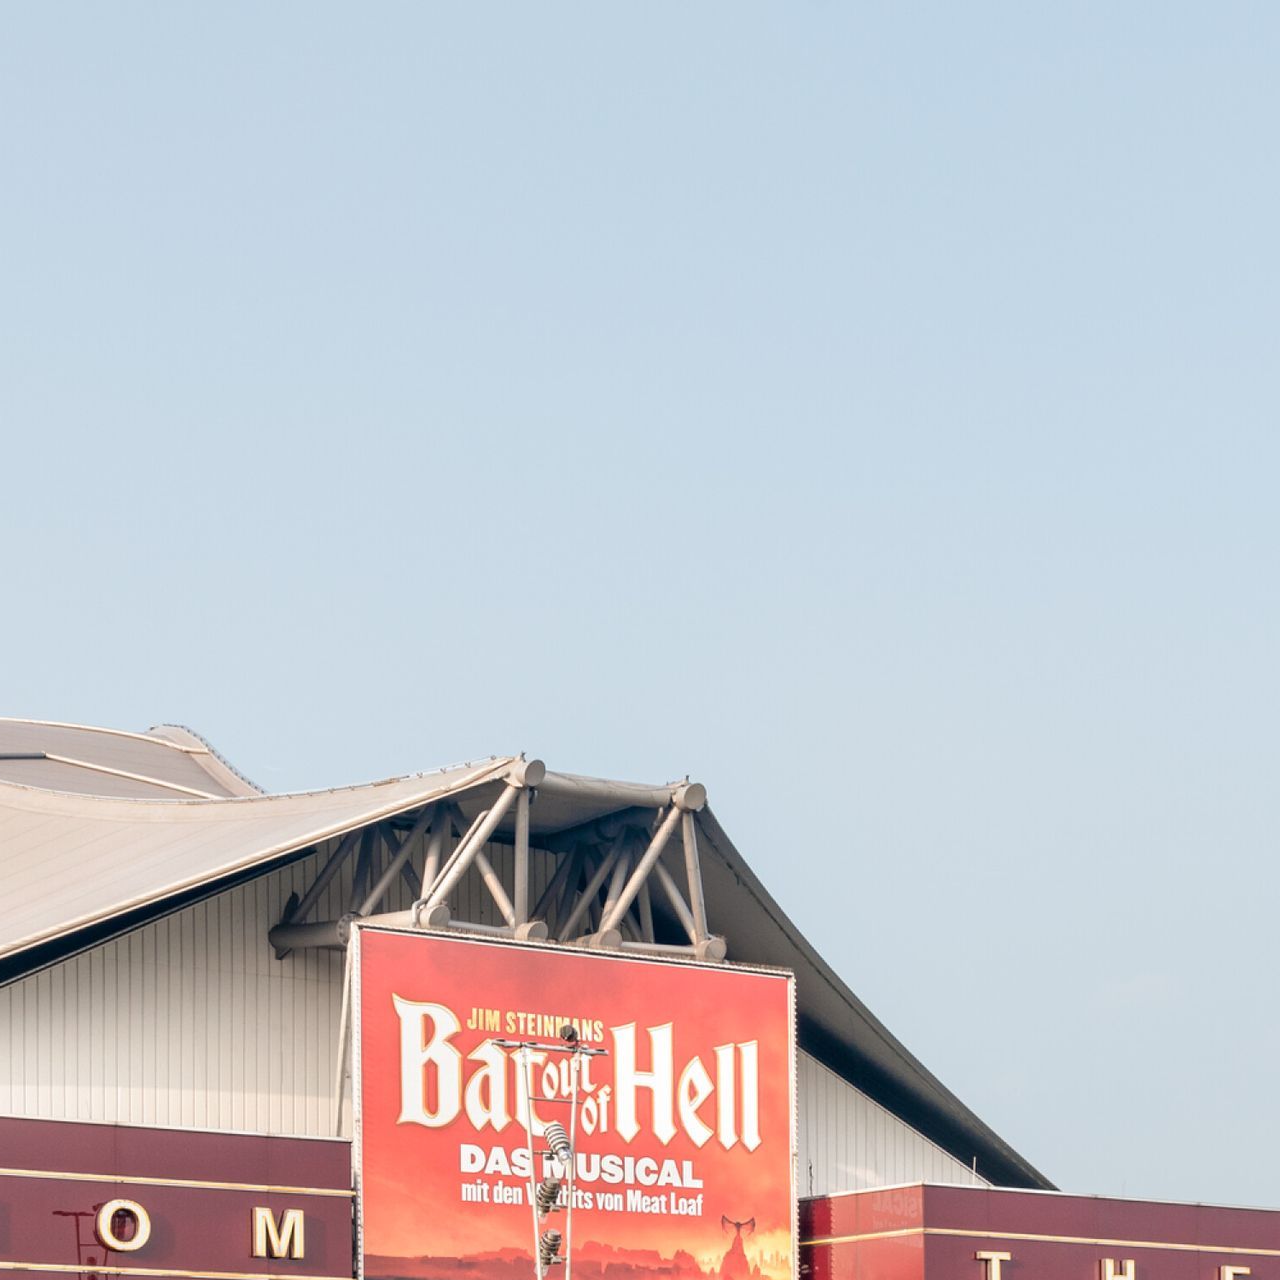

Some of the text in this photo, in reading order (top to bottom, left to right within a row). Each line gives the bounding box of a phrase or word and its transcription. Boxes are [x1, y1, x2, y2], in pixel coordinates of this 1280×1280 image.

[467, 1008, 604, 1043] JIM STEINMANS
[392, 993, 762, 1152] Bat out of Hell
[460, 1144, 704, 1189] DAS MUSICAL
[461, 1179, 490, 1203] mit
[493, 1180, 523, 1205] den
[596, 1192, 624, 1211] von
[626, 1190, 668, 1214] Meat
[670, 1192, 704, 1217] Loaf
